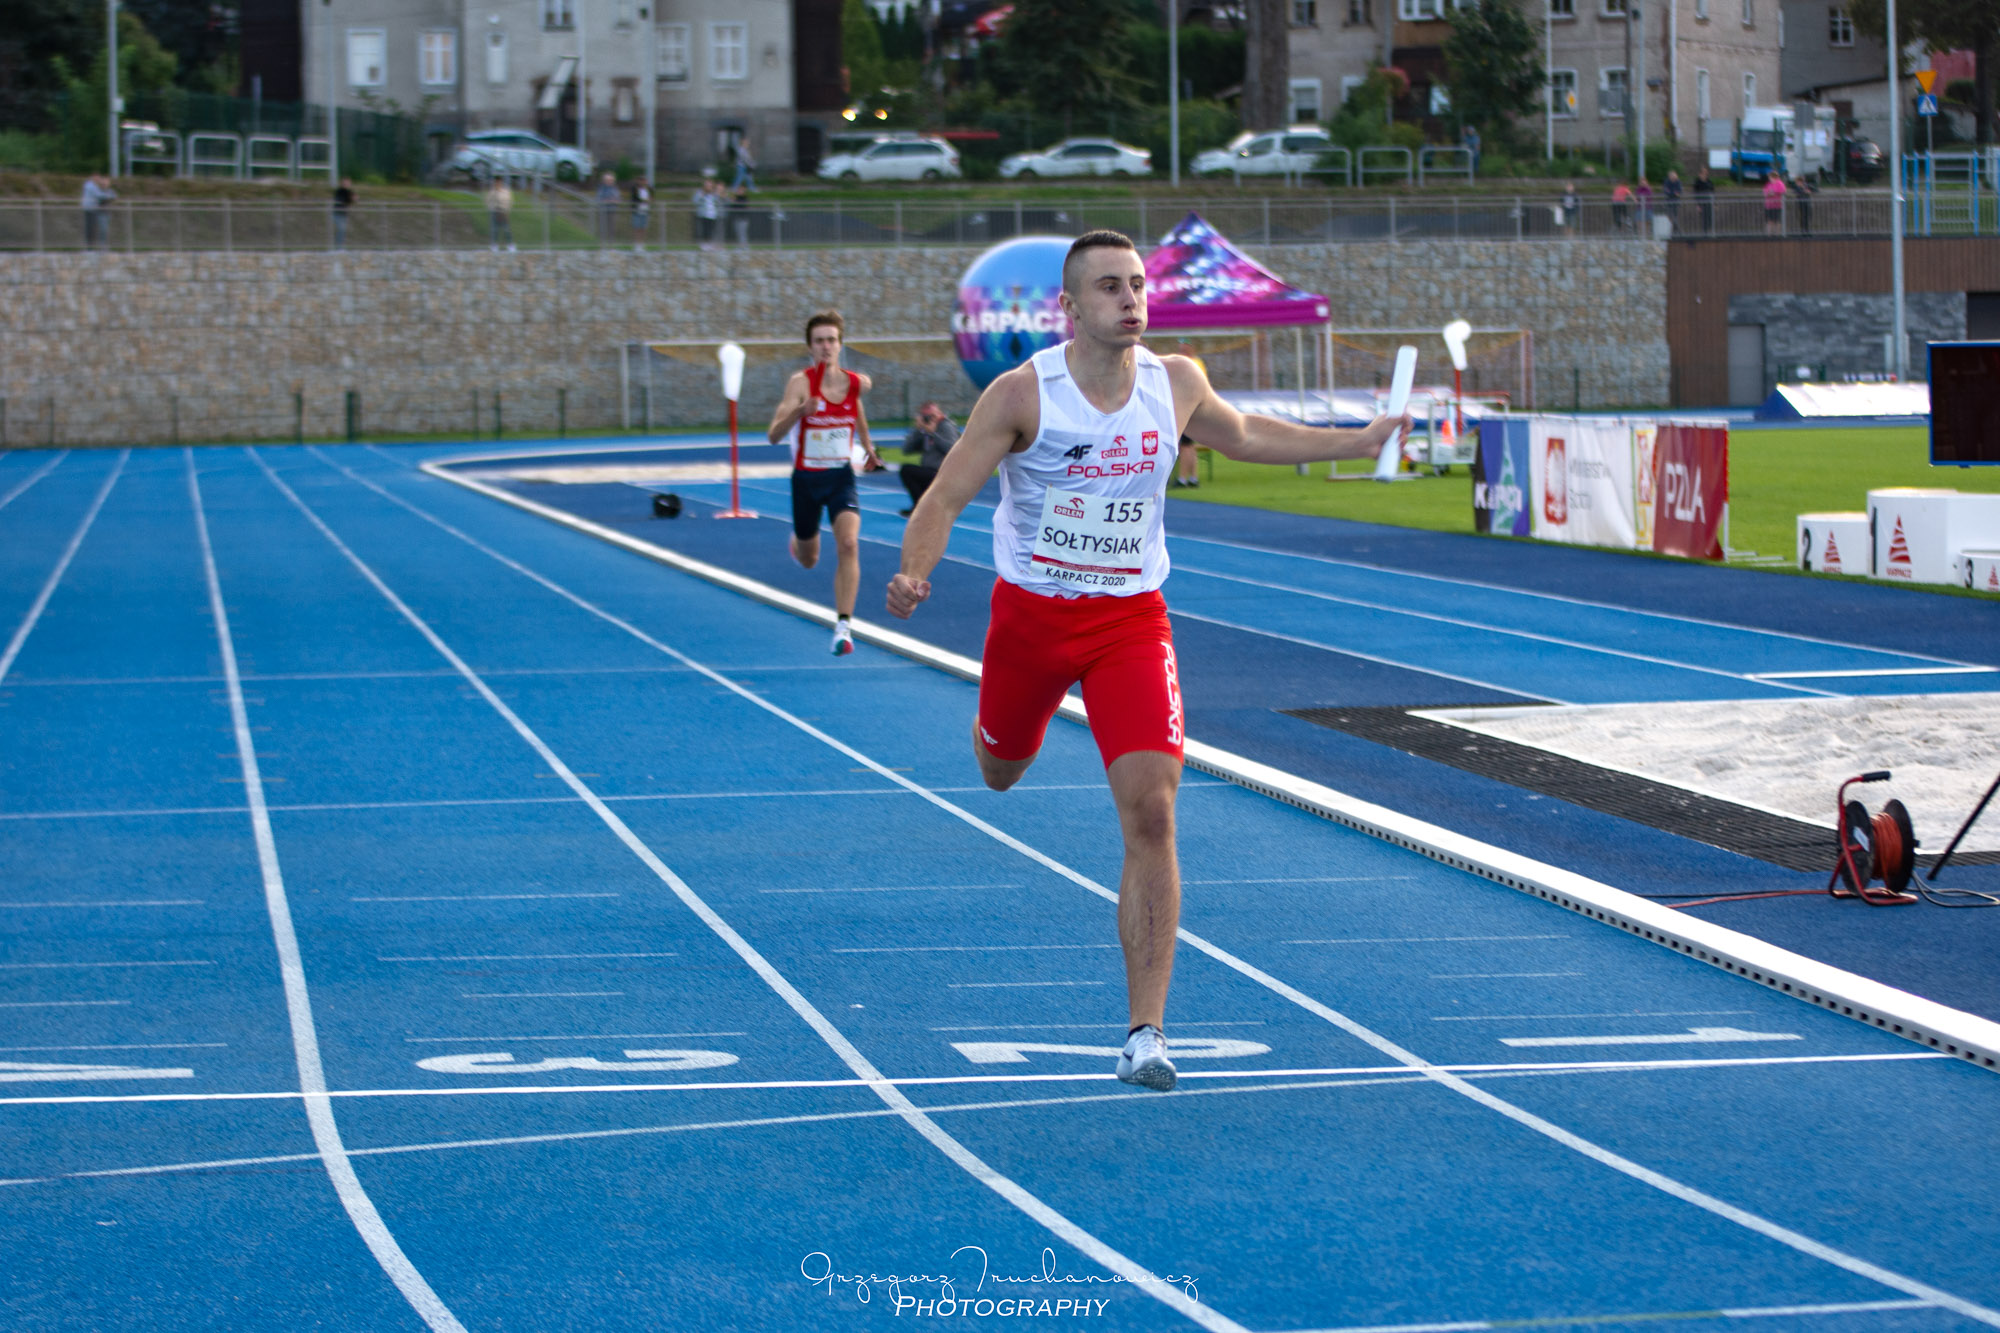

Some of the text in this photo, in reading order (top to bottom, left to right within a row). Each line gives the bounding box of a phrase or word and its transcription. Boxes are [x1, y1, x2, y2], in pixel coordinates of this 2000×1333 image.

[1064, 444, 1093, 460] 4F
[1102, 447, 1128, 459] ORLEN
[1067, 461, 1155, 479] POLSKA
[1054, 506, 1084, 519] ORLEN
[1103, 502, 1144, 523] 155
[1042, 526, 1142, 554] SOŁTYSIAK
[1802, 527, 1812, 571] 2
[1045, 567, 1099, 585] KARPACZ
[1102, 575, 1126, 586] 2020
[1160, 641, 1182, 746] POLSKA
[1500, 1027, 1802, 1048] 1
[950, 1037, 1272, 1064] 2
[415, 1049, 740, 1075] 3
